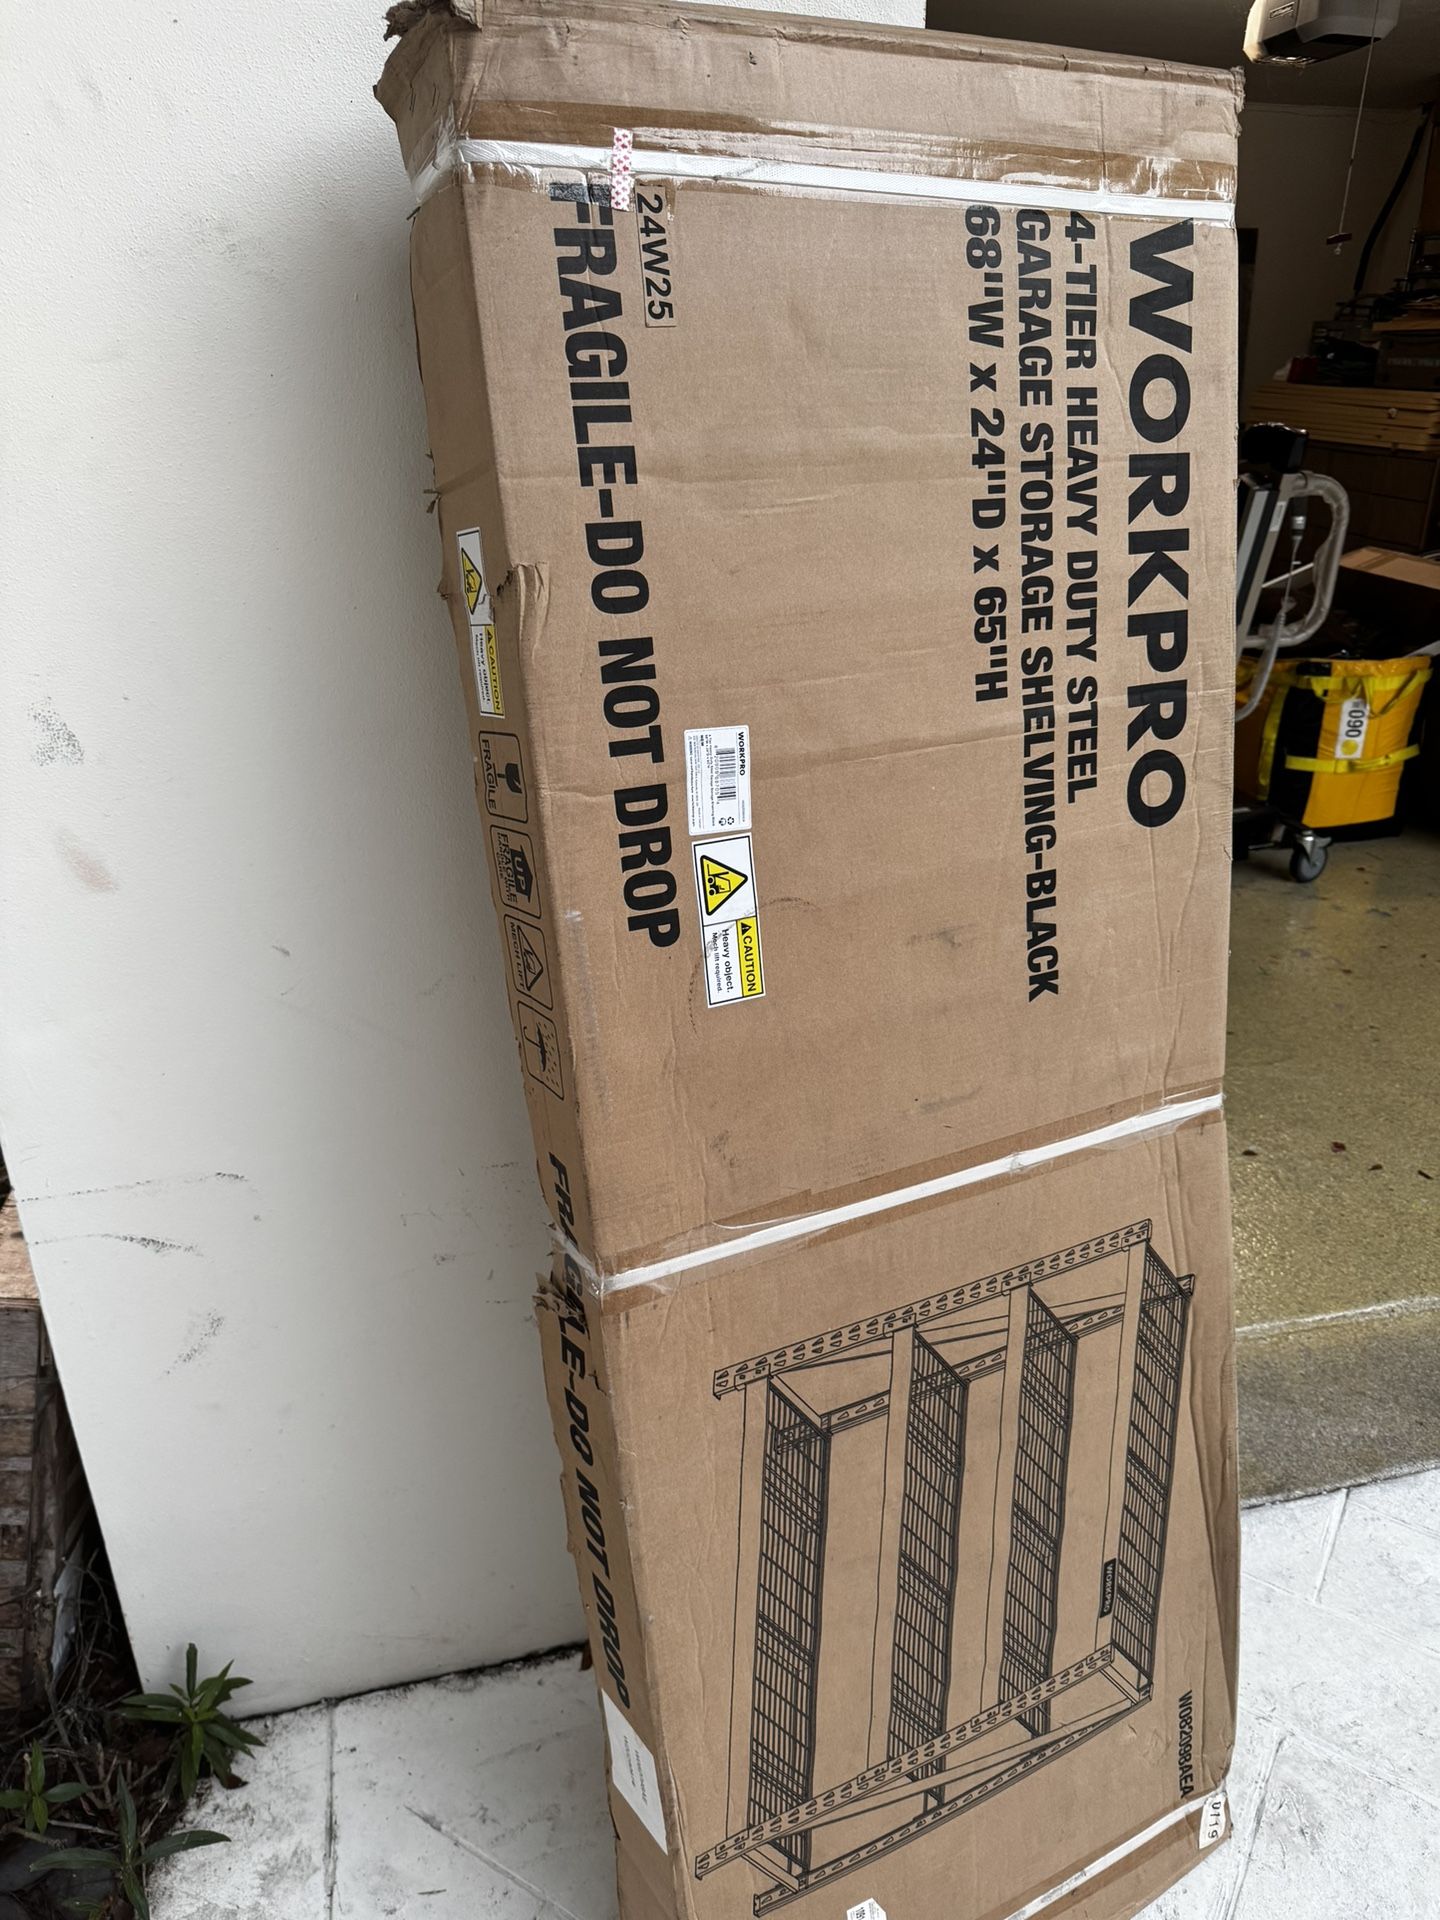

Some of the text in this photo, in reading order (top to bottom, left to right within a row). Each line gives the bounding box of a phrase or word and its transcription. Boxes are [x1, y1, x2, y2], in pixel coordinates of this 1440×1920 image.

[637, 193, 674, 320] 24W25
[1065, 211, 1098, 804] 4-TIER HEAVY DUTY STEEL
[1127, 217, 1195, 828] WORKPRO
[549, 182, 681, 948] FRAGILE-DO NOT DROP
[1016, 208, 1059, 1002] GARAGE STORAGE SHELVING-BLACK
[489, 646, 501, 710] CAUTION
[482, 739, 497, 810] FRAGILE
[738, 731, 746, 776] WORKPRO
[500, 834, 518, 903] FRAGILE
[514, 857, 526, 890] UP
[510, 922, 525, 990] MECH LIFT
[721, 929, 734, 993] Heavy object.
[743, 936, 757, 992] CAUTION
[576, 1468, 610, 1579] NOT
[592, 1573, 631, 1710] DROP
[1178, 1690, 1194, 1799] W082098AEA
